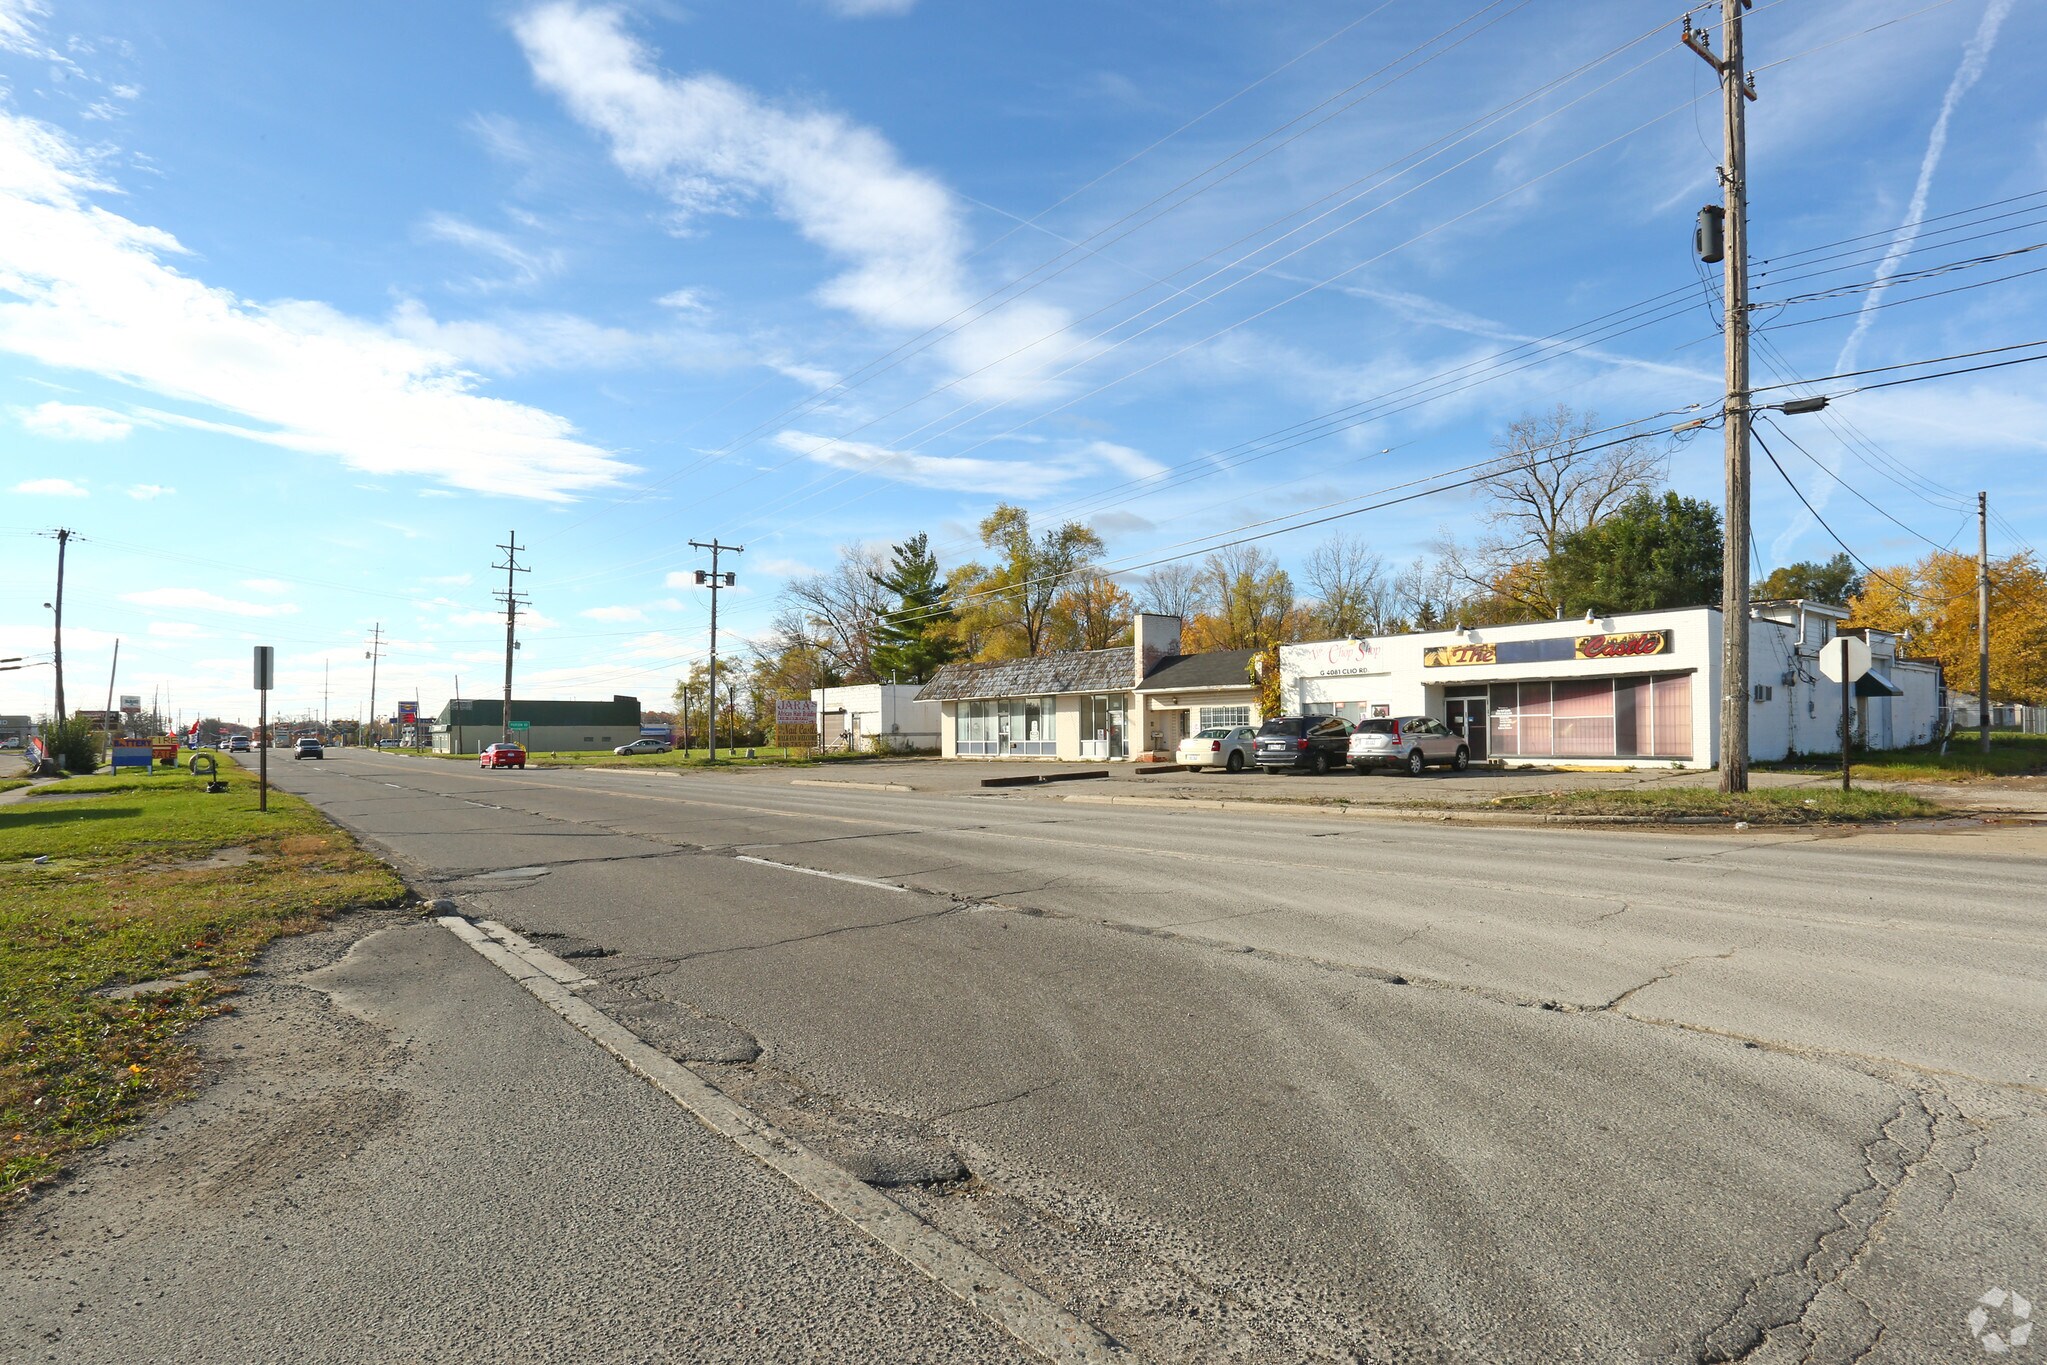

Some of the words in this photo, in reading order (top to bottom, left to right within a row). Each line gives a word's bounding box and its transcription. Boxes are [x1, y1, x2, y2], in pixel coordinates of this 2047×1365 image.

[1453, 647, 1494, 663] The
[1584, 634, 1660, 658] Castle
[115, 740, 152, 748] BATTERY
